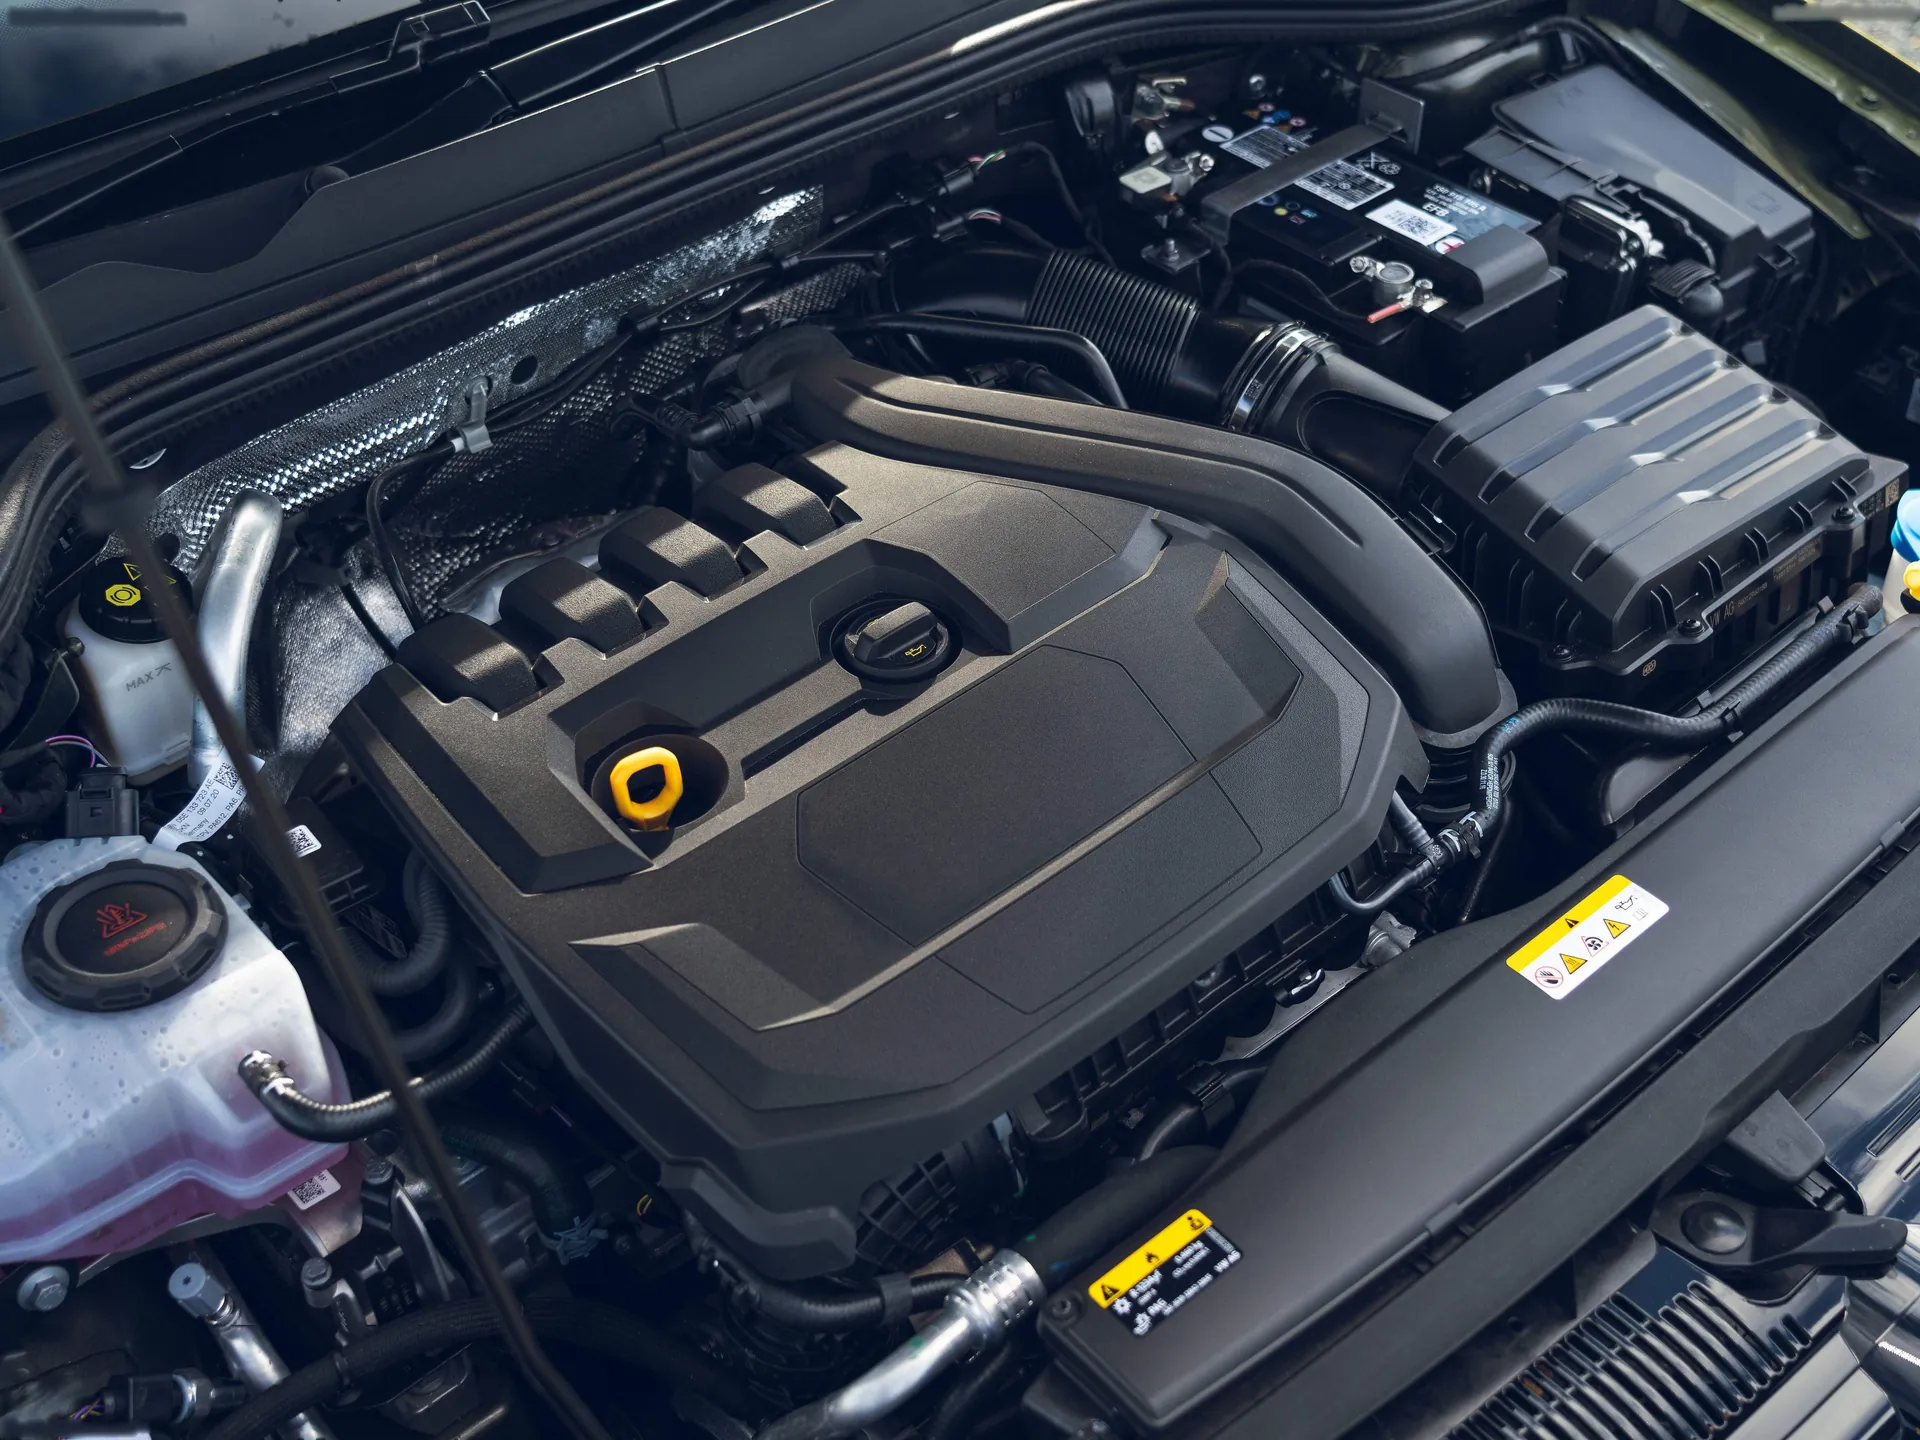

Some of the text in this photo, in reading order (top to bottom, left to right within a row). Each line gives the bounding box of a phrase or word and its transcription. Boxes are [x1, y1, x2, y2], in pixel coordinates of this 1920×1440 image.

[1422, 202, 1449, 217] EFB
[1724, 601, 1735, 618] AG
[126, 671, 154, 691] MAX
[187, 802, 199, 814] 133
[196, 789, 208, 802] 723
[1214, 1258, 1230, 1273] VW
[1227, 1249, 1241, 1264] AG
